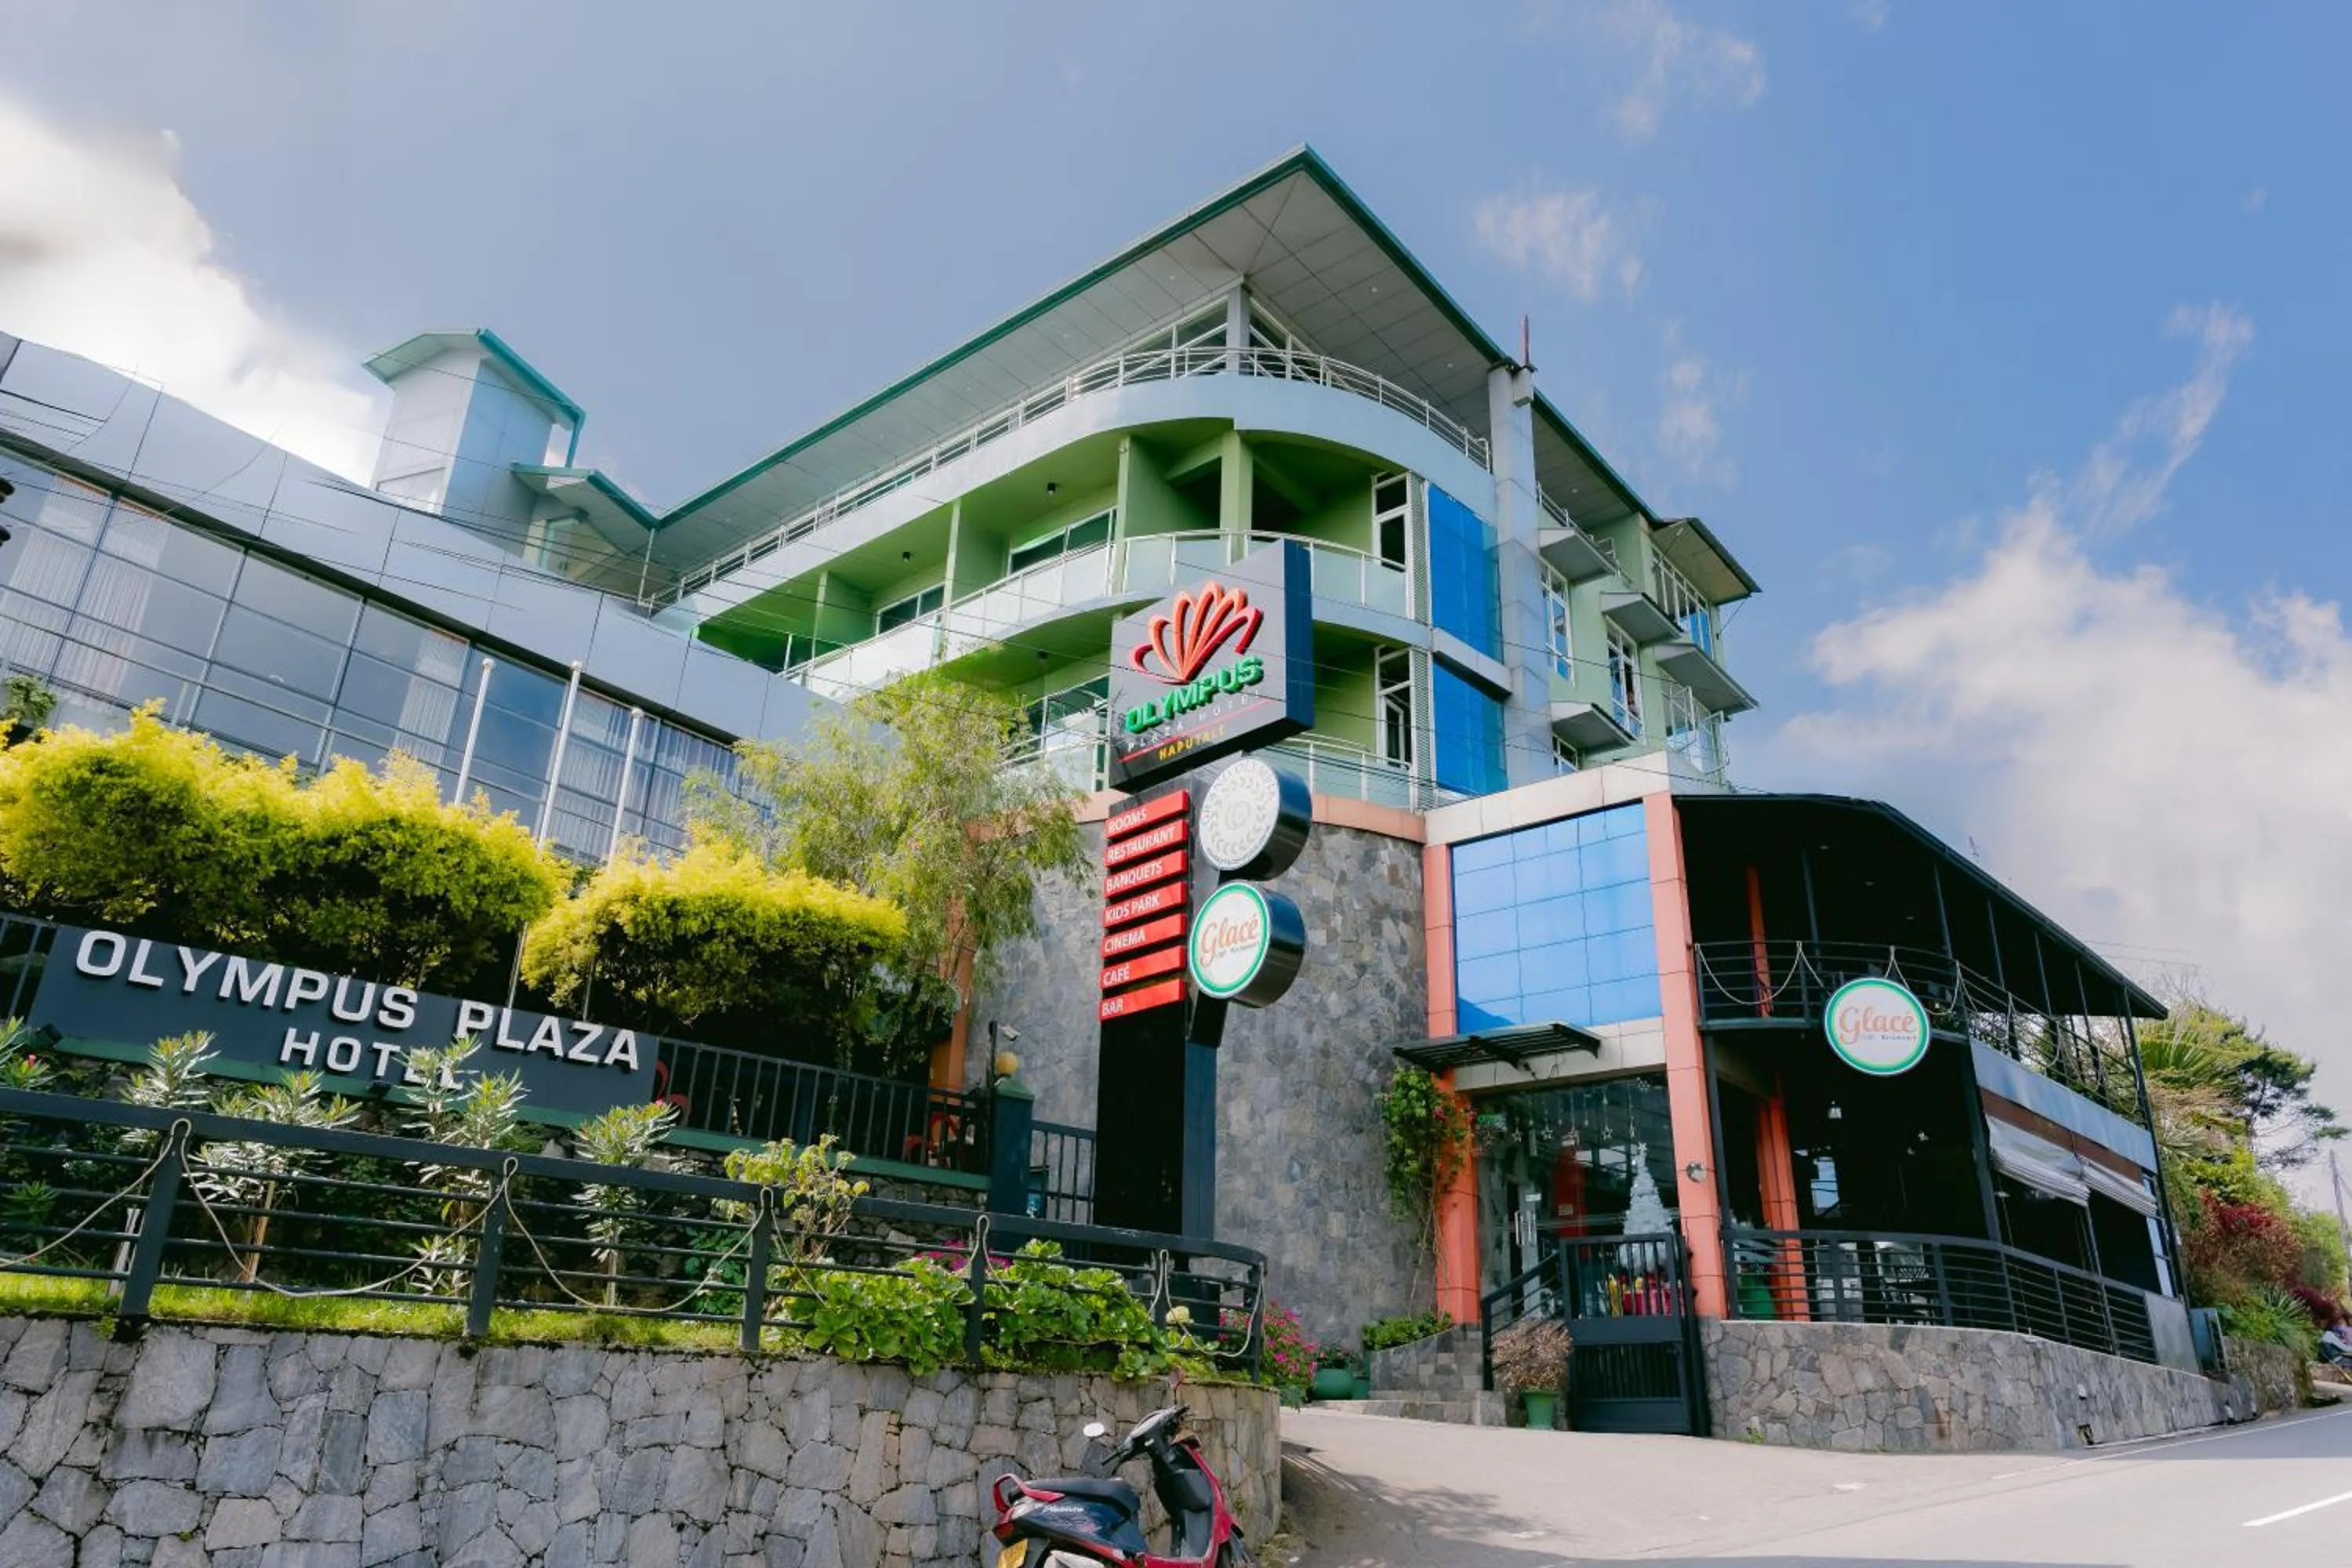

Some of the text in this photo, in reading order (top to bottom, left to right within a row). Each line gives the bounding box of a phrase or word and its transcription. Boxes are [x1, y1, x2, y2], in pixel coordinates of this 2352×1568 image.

[1124, 655, 1264, 734] OLYMPUS
[1127, 721, 1185, 752] PLAZA
[1158, 724, 1225, 760] HAPUTALE
[1107, 808, 1148, 833] ROOMS
[1107, 828, 1174, 862] RESTAURANT
[1106, 862, 1163, 892] BANQUETS
[1105, 893, 1160, 920] KIDS PARK
[1104, 931, 1146, 952] CINEMA
[1102, 964, 1131, 982] CAFÉ
[75, 931, 640, 1071] OLYMPUS PLAZA
[1101, 998, 1124, 1014] BAR
